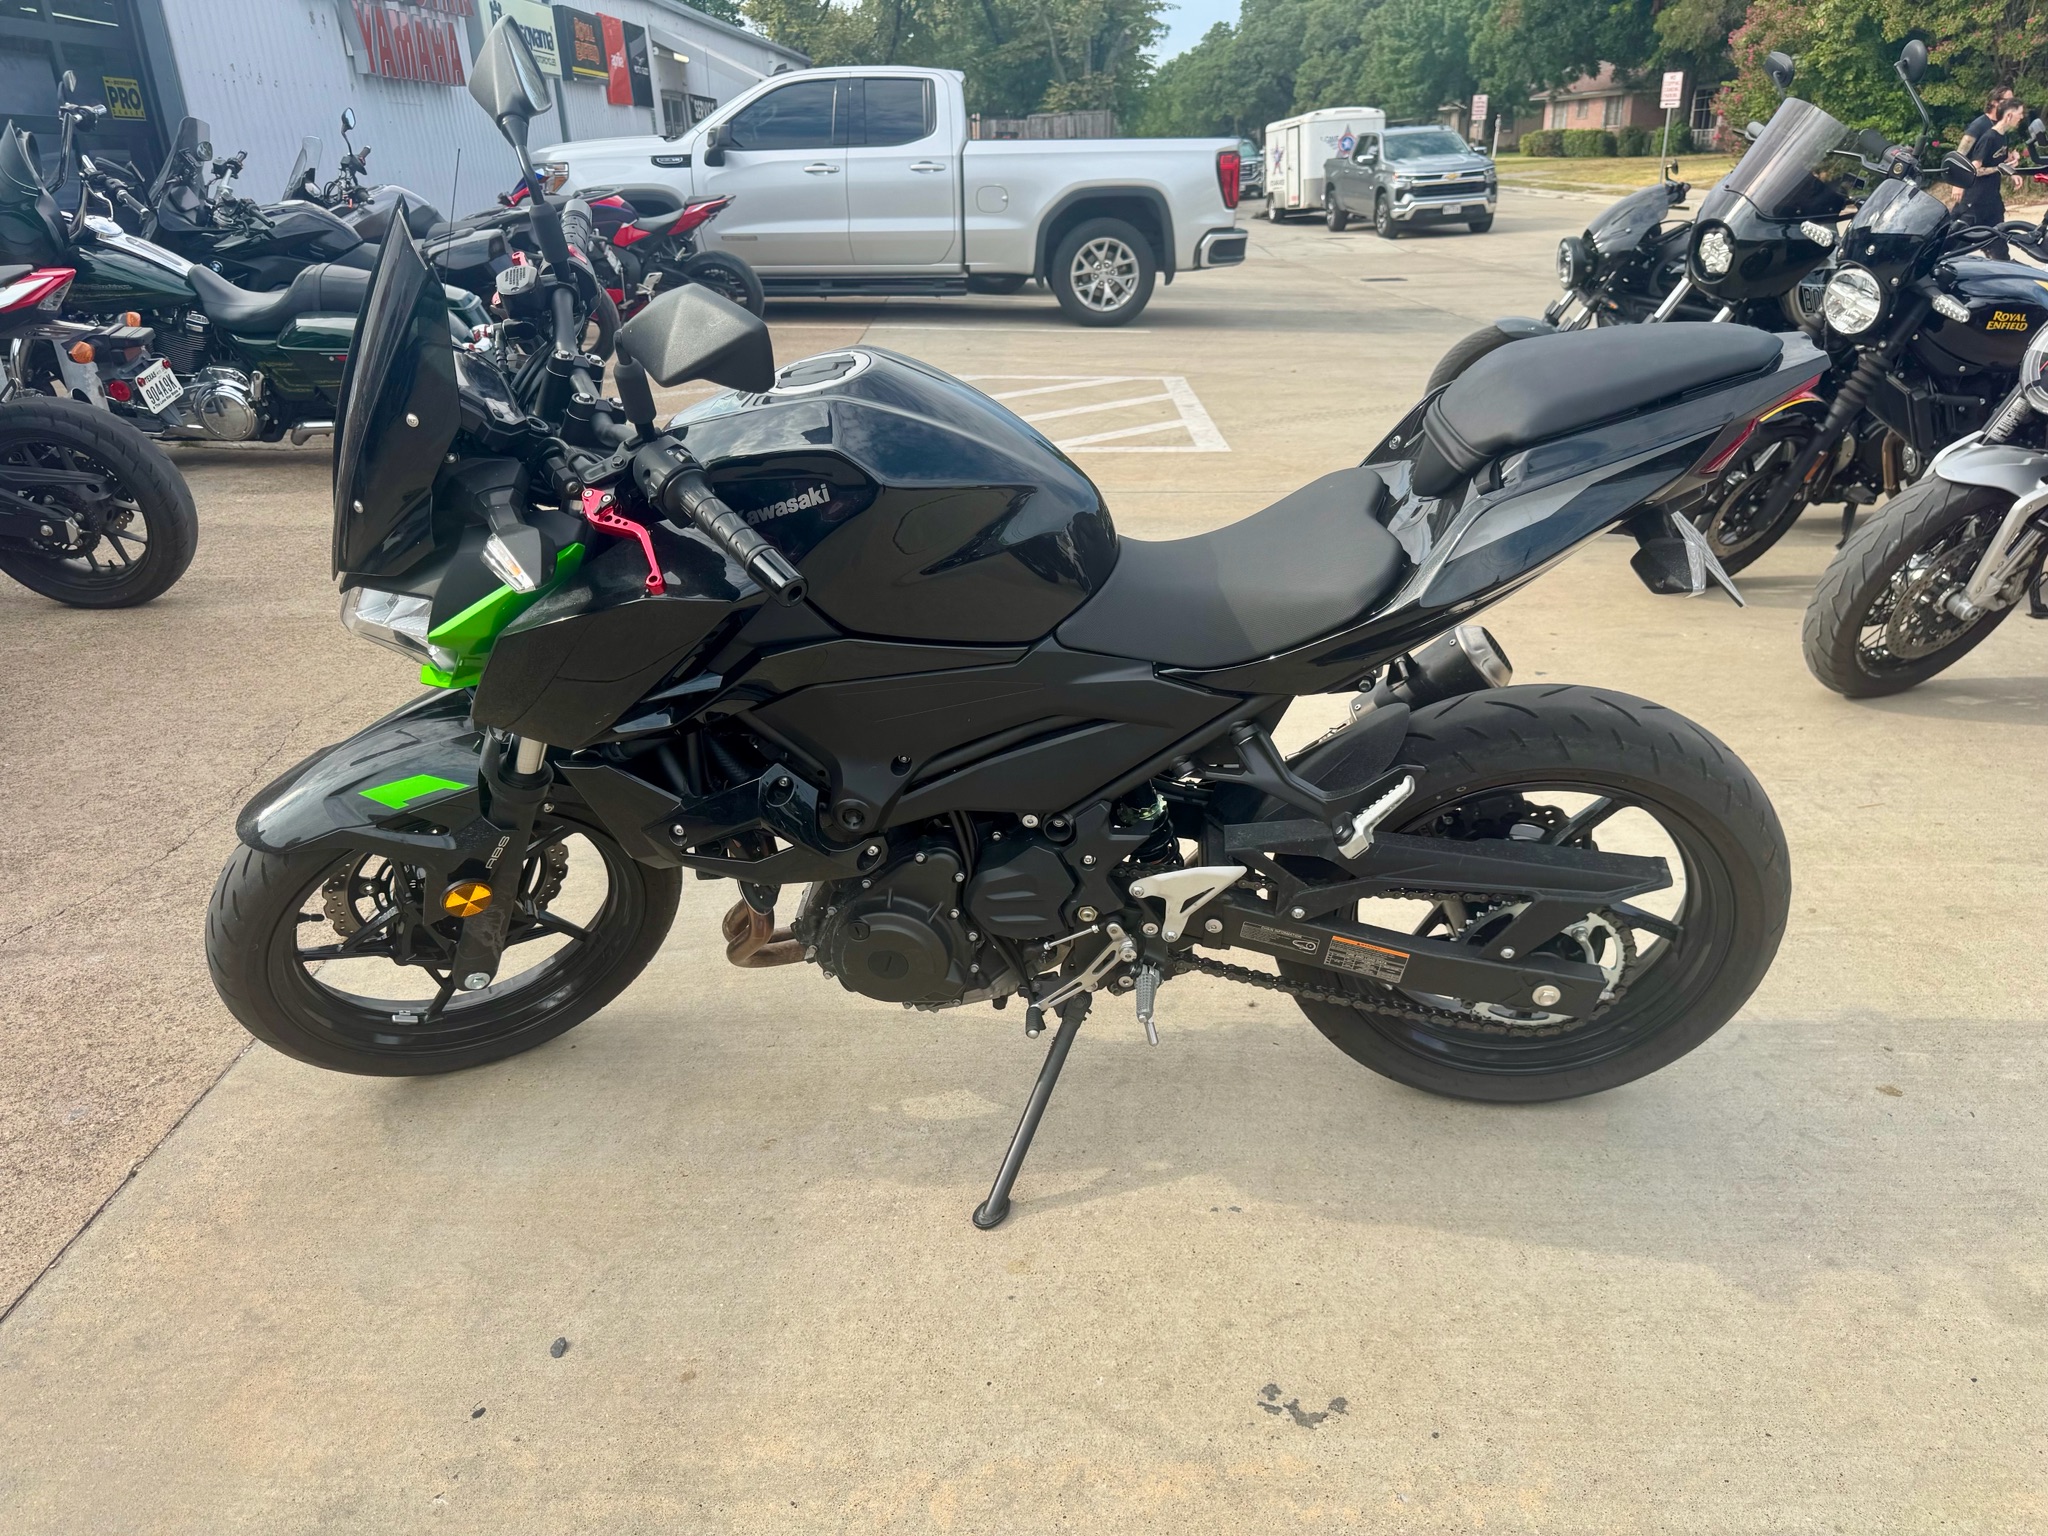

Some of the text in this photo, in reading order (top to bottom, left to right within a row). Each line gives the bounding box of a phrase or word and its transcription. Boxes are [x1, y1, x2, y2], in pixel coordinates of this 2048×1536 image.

[351, 0, 467, 87] YAMAHA
[106, 85, 142, 111] PRO
[1986, 320, 2028, 332] ENFIELD
[1993, 311, 2027, 322] ROYAL
[144, 371, 158, 384] TEXAS
[145, 373, 178, 405] 904A9K
[740, 483, 831, 526] awasaki
[485, 835, 511, 869] ABS
